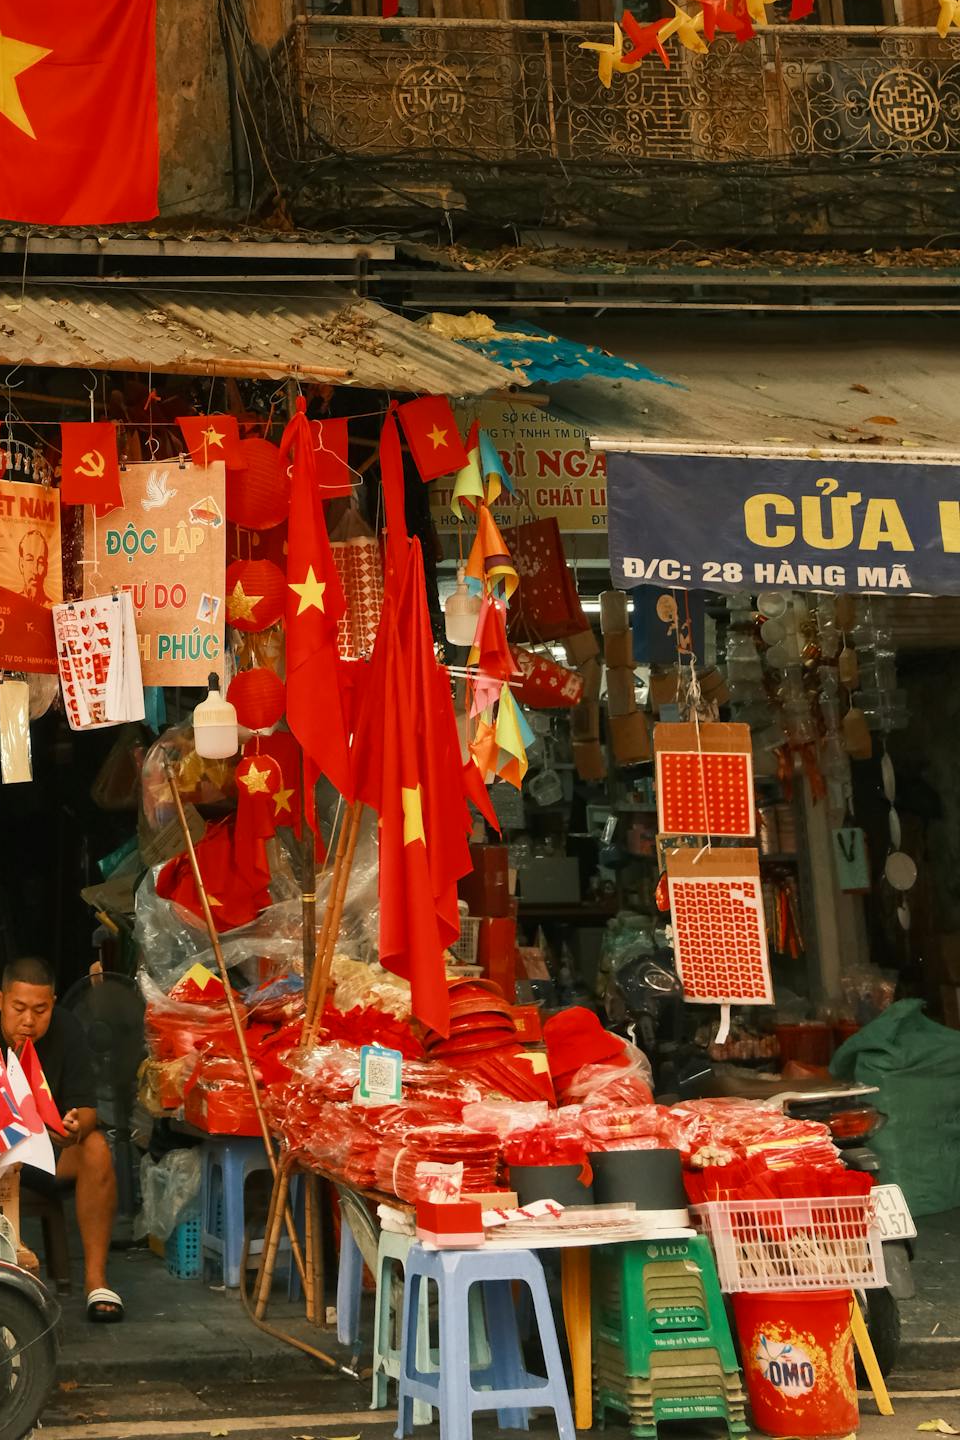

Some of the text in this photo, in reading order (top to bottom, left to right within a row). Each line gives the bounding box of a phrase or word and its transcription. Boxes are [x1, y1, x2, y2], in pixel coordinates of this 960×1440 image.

[520, 428, 550, 438] TNHH
[554, 428, 570, 438] TM
[537, 483, 583, 506] CHẤT
[20, 496, 55, 522] NAM
[744, 478, 915, 552] CỬA
[106, 520, 205, 562] ĐỘC LẬP
[622, 557, 912, 588] Đ/C: 28 HÀNG MÃ
[154, 583, 187, 609] DO
[158, 626, 220, 661] PHÚC
[769, 1361, 814, 1388] OMO
